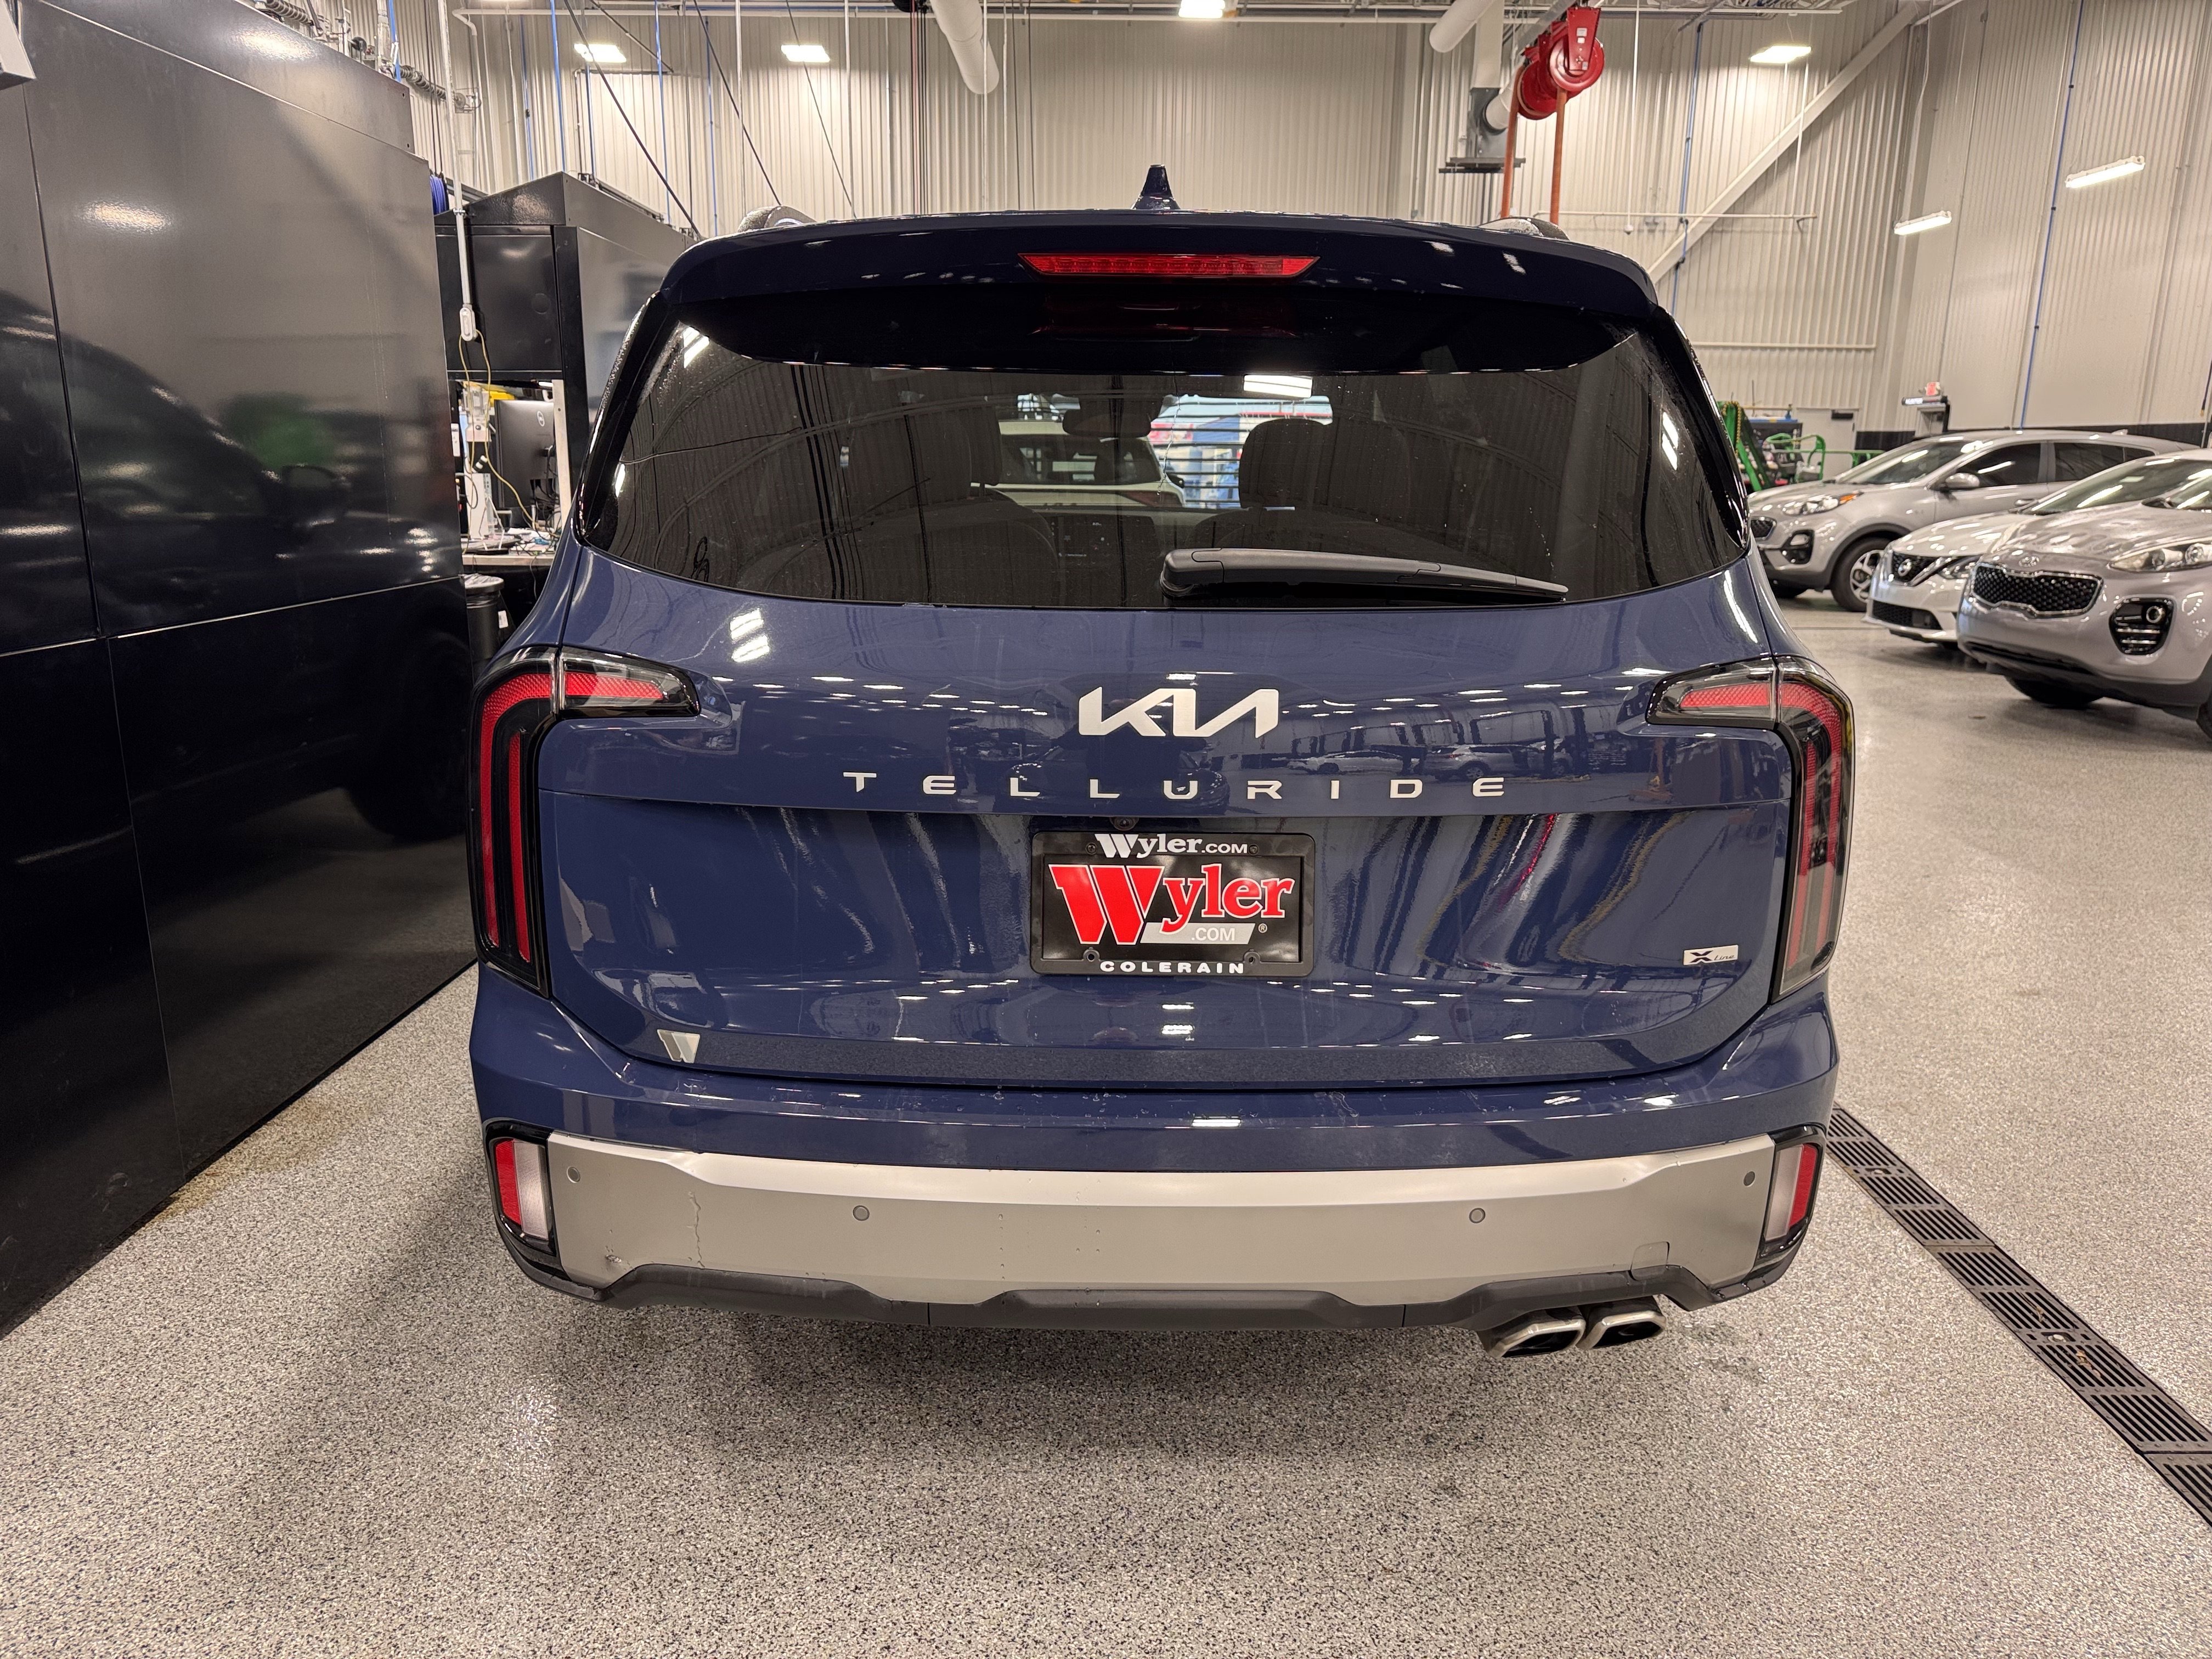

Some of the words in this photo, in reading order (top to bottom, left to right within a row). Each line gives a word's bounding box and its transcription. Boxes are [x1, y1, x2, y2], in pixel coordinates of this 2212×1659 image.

[1078, 687, 1279, 738] KIA
[843, 772, 1505, 799] TELLURIDE
[1048, 864, 1295, 945] Wyler
[1191, 927, 1235, 941] .COM
[1100, 961, 1244, 974] COLERAIN
